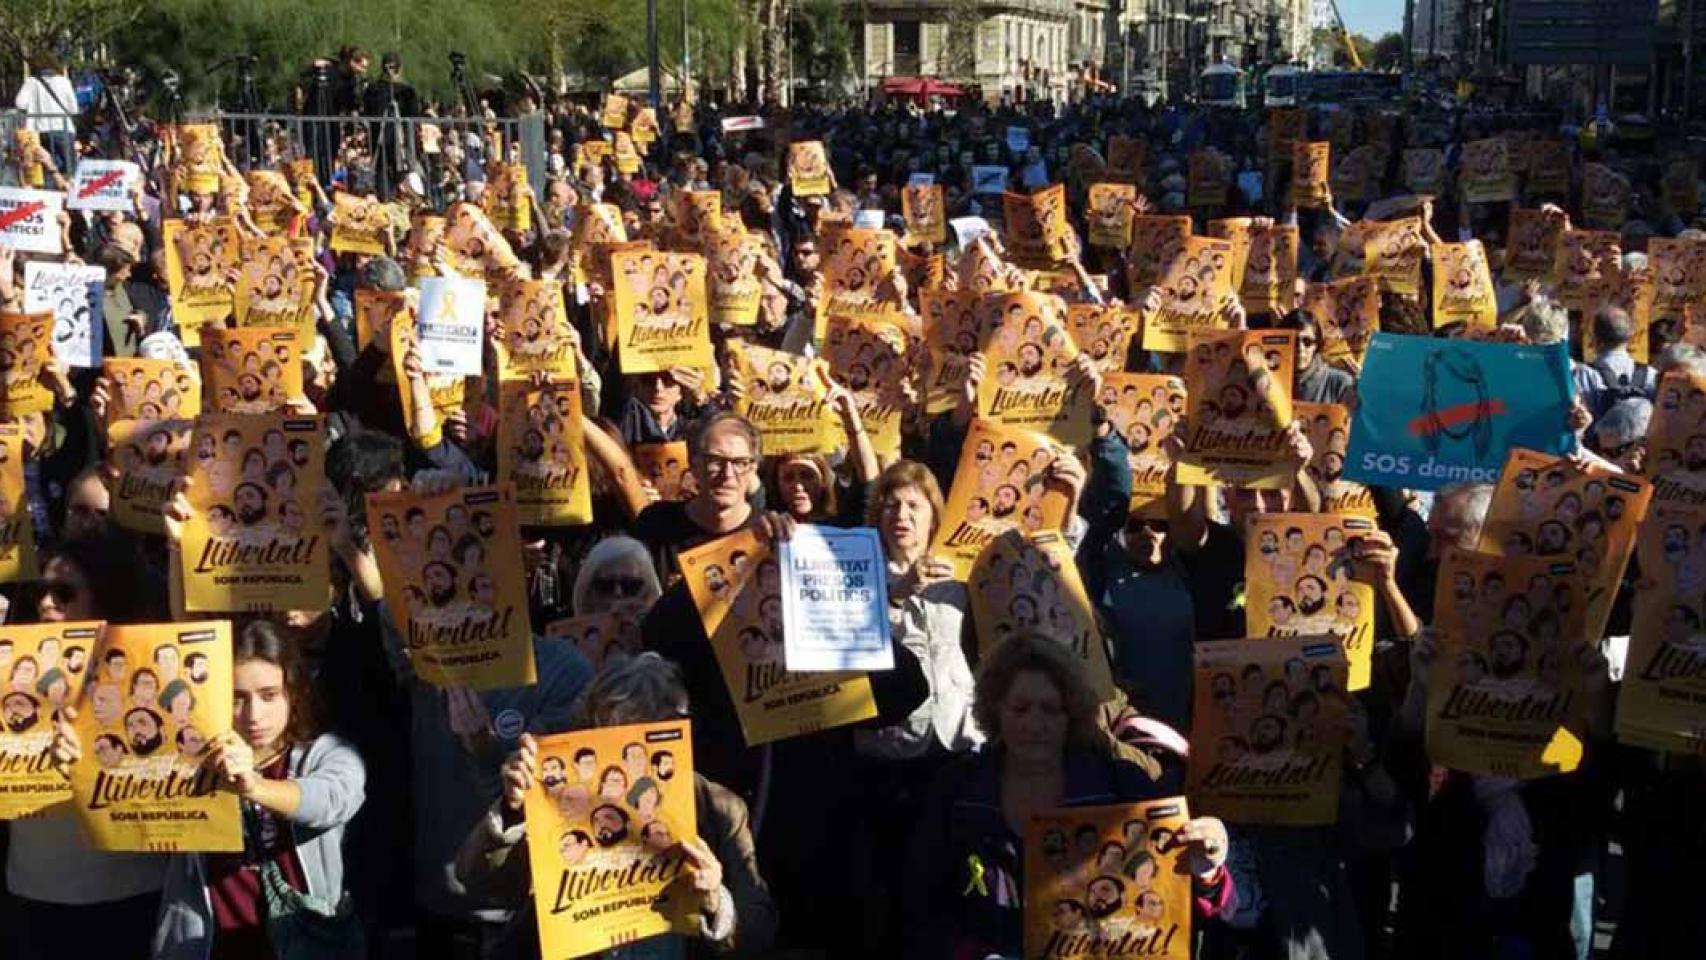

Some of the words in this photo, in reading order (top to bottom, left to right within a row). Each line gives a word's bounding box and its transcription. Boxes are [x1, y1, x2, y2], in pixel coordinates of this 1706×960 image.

[1362, 453, 1409, 475] SOS
[1418, 457, 1499, 481] democ
[572, 905, 601, 923] SOM
